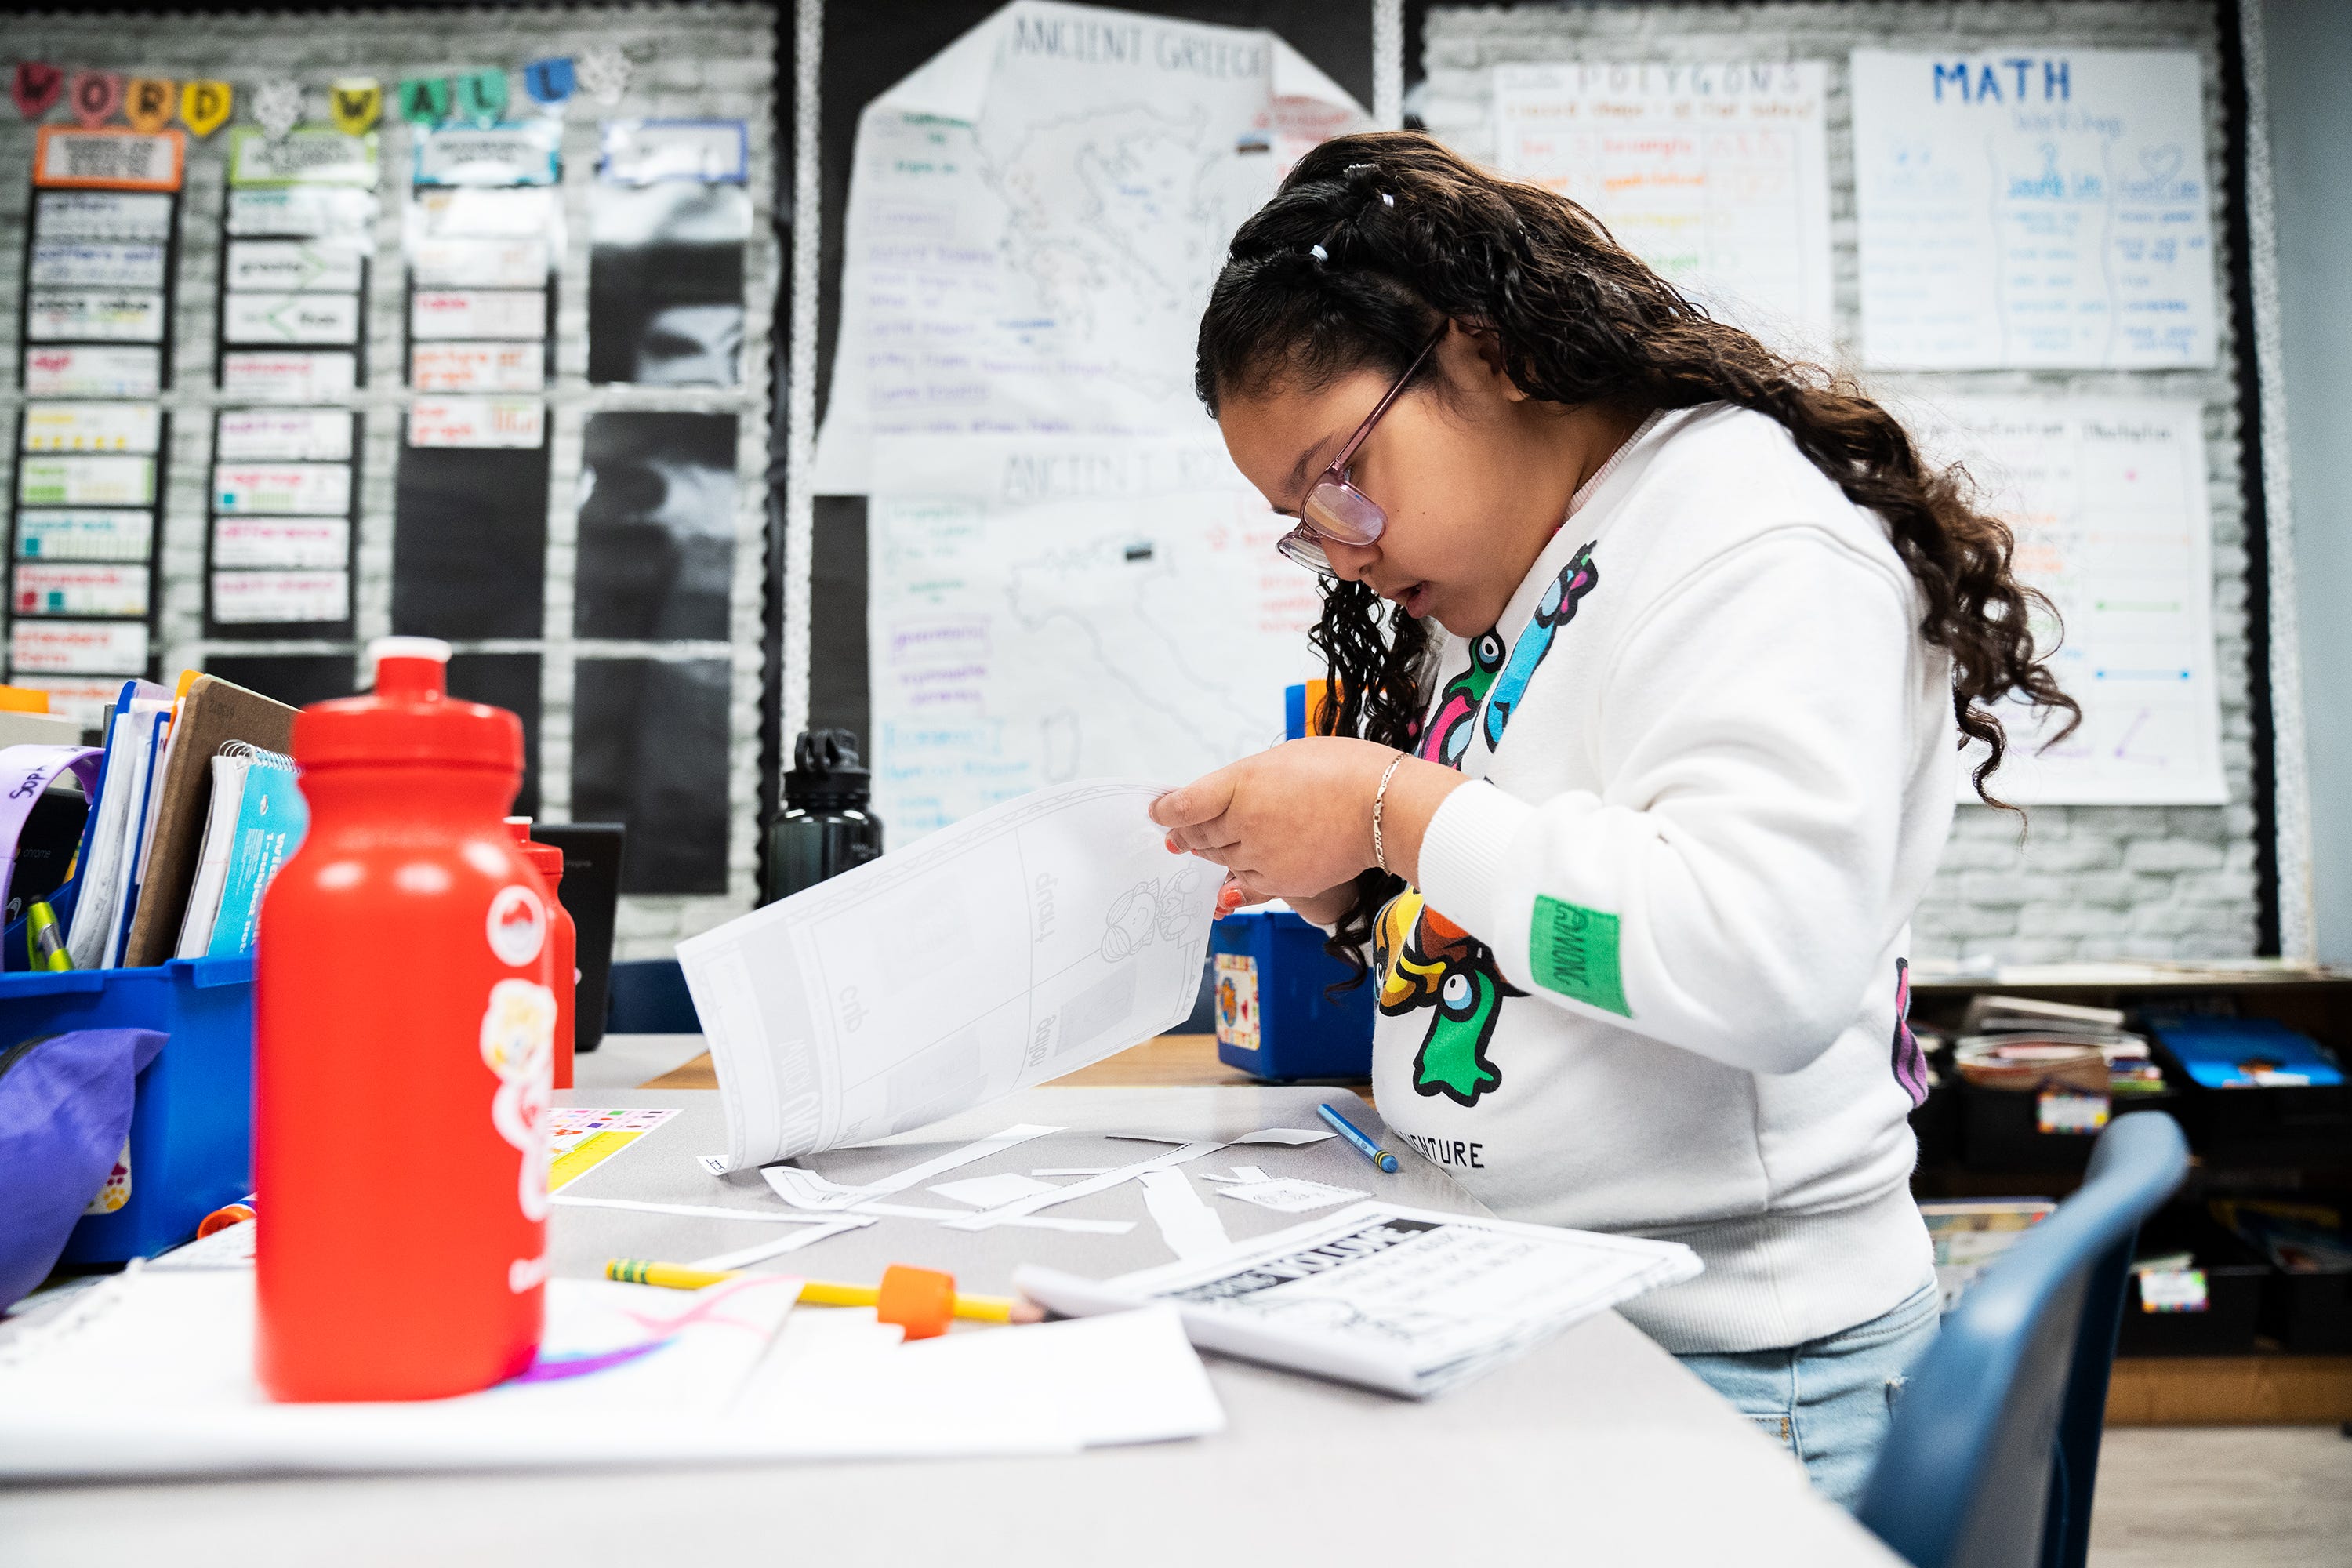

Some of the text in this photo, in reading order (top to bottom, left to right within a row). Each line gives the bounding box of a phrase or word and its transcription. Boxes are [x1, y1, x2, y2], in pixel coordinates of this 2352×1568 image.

[1013, 15, 1142, 66] ANCIENT
[19, 64, 564, 122] WORD WALL
[1577, 62, 1801, 96] POLYGONS
[1933, 59, 2071, 103] MATH
[23, 848, 52, 858] chrome
[247, 832, 274, 916] 1-subject
[1256, 1225, 1425, 1278] VOLUME
